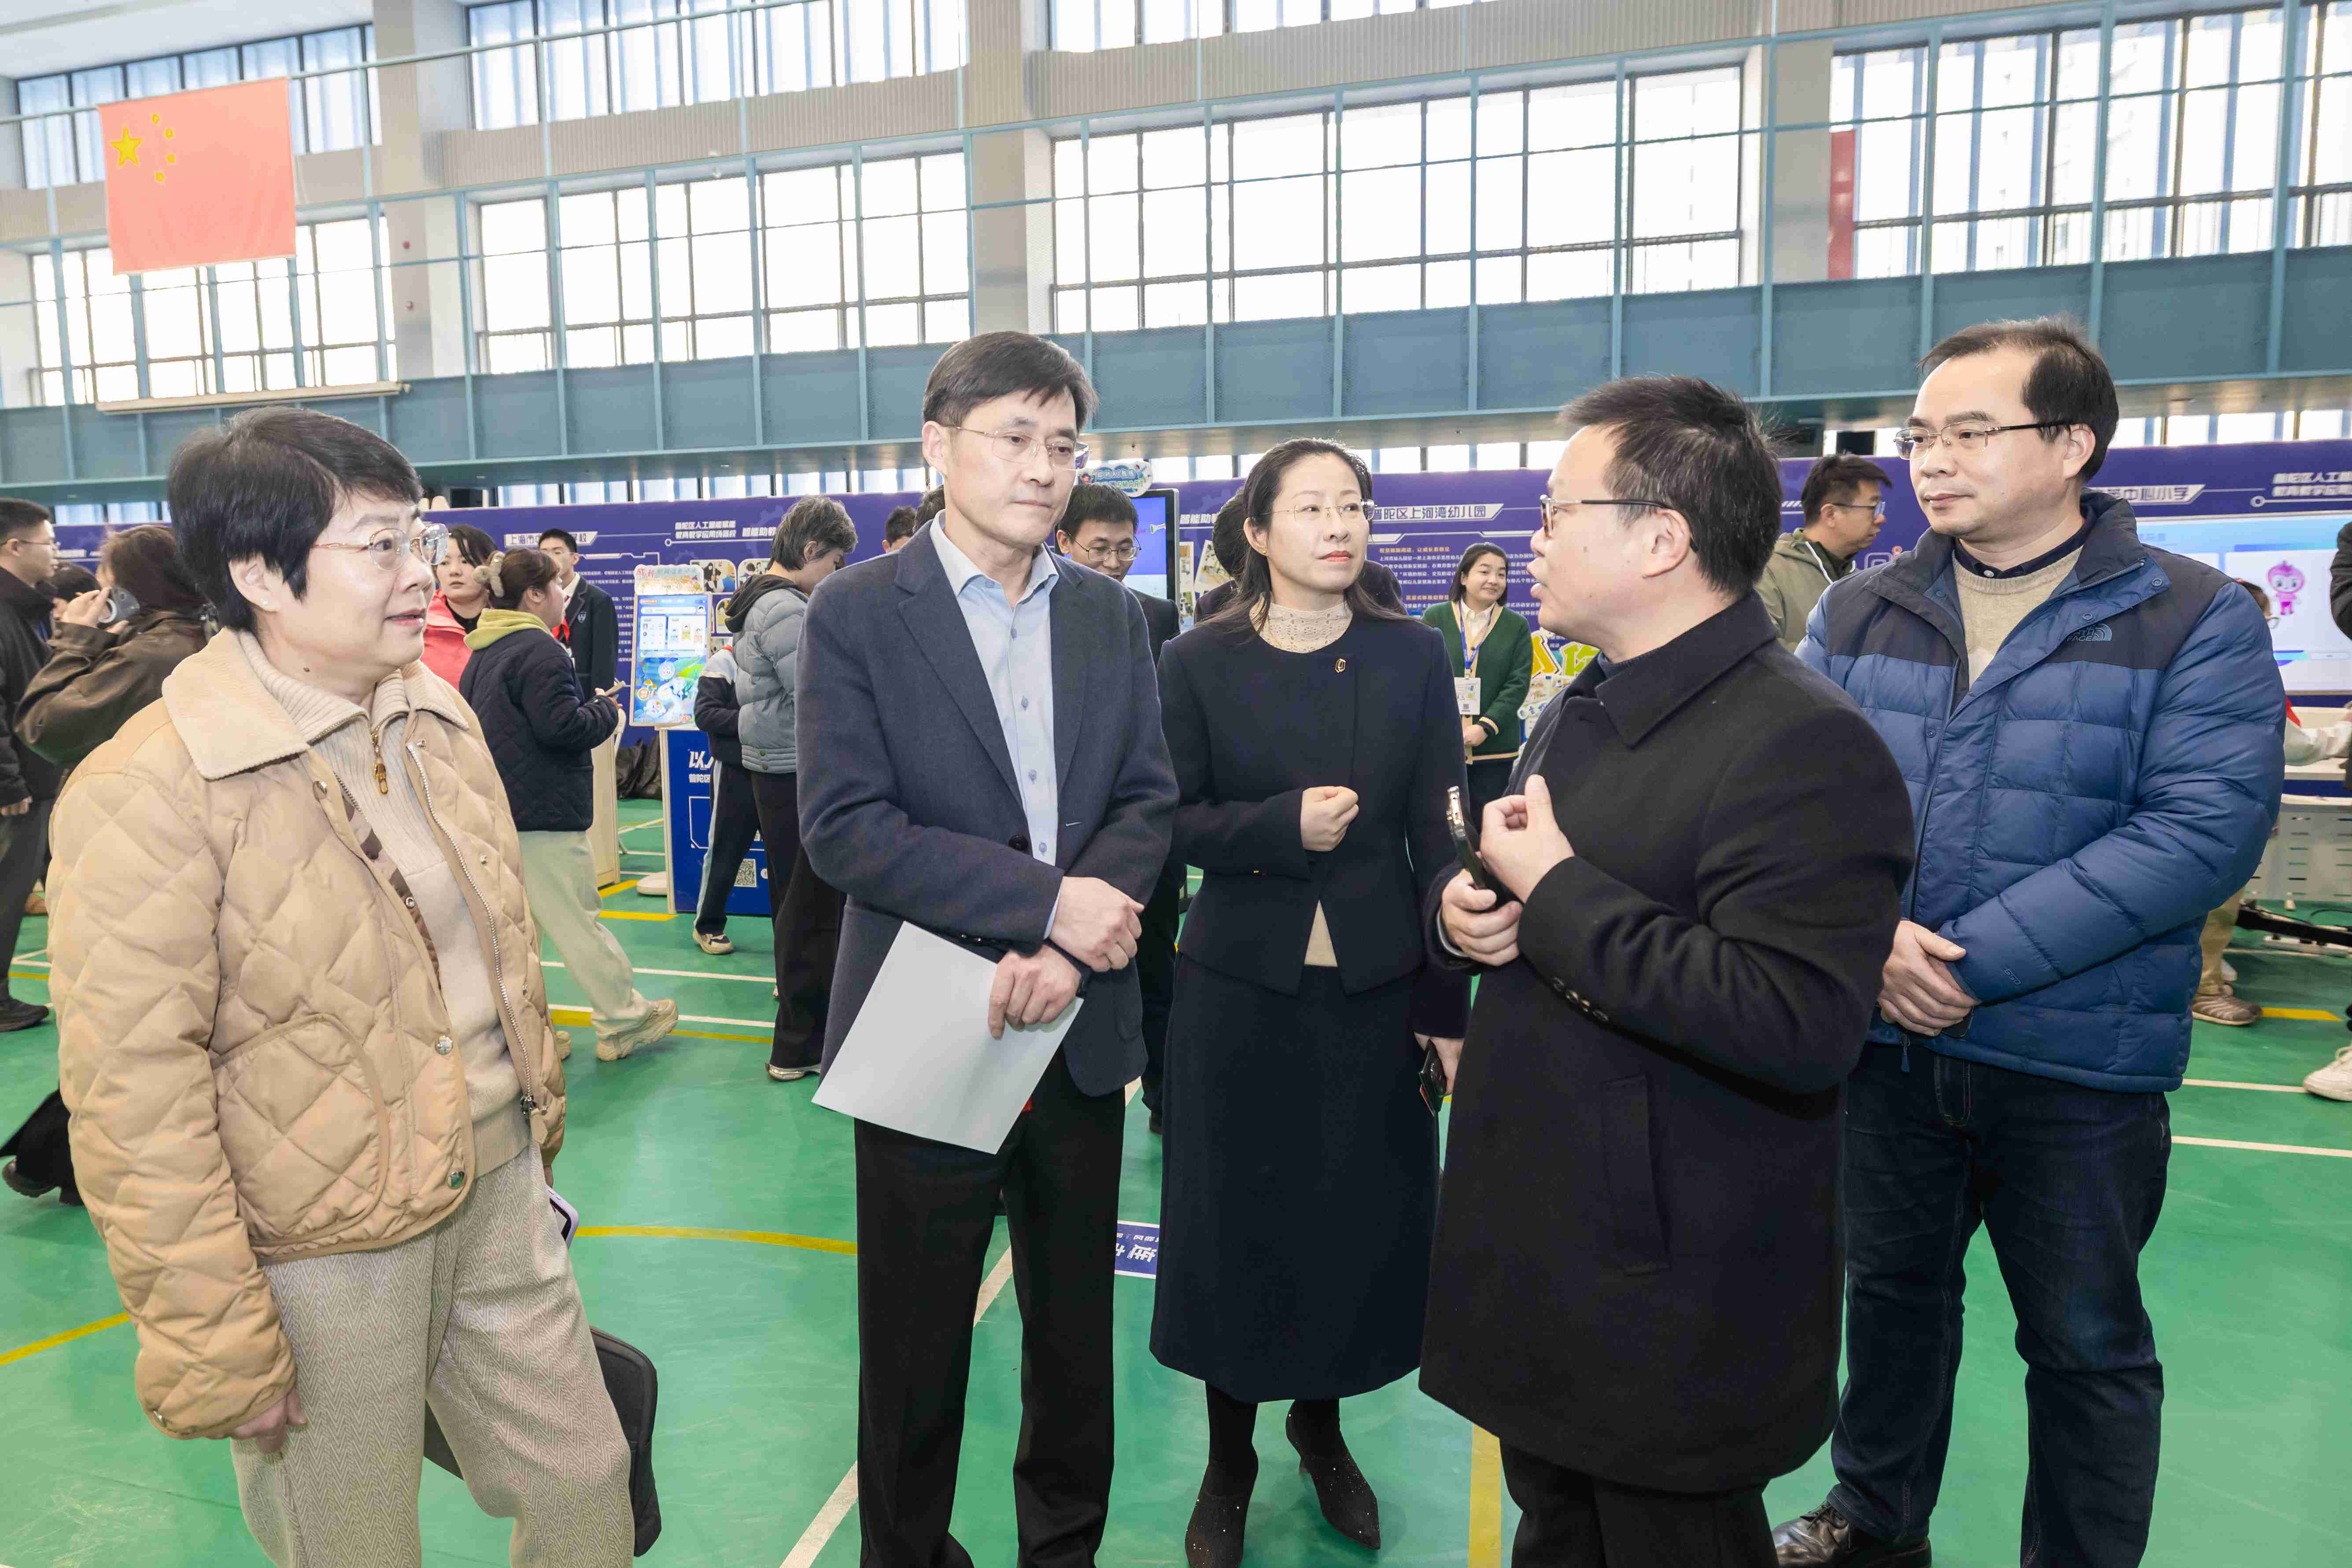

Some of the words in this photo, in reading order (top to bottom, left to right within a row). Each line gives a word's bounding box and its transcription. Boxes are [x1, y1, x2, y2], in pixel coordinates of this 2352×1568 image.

[1368, 506, 1486, 520] 普陀区上河湾幼儿园
[689, 774, 711, 783] 普陀区
